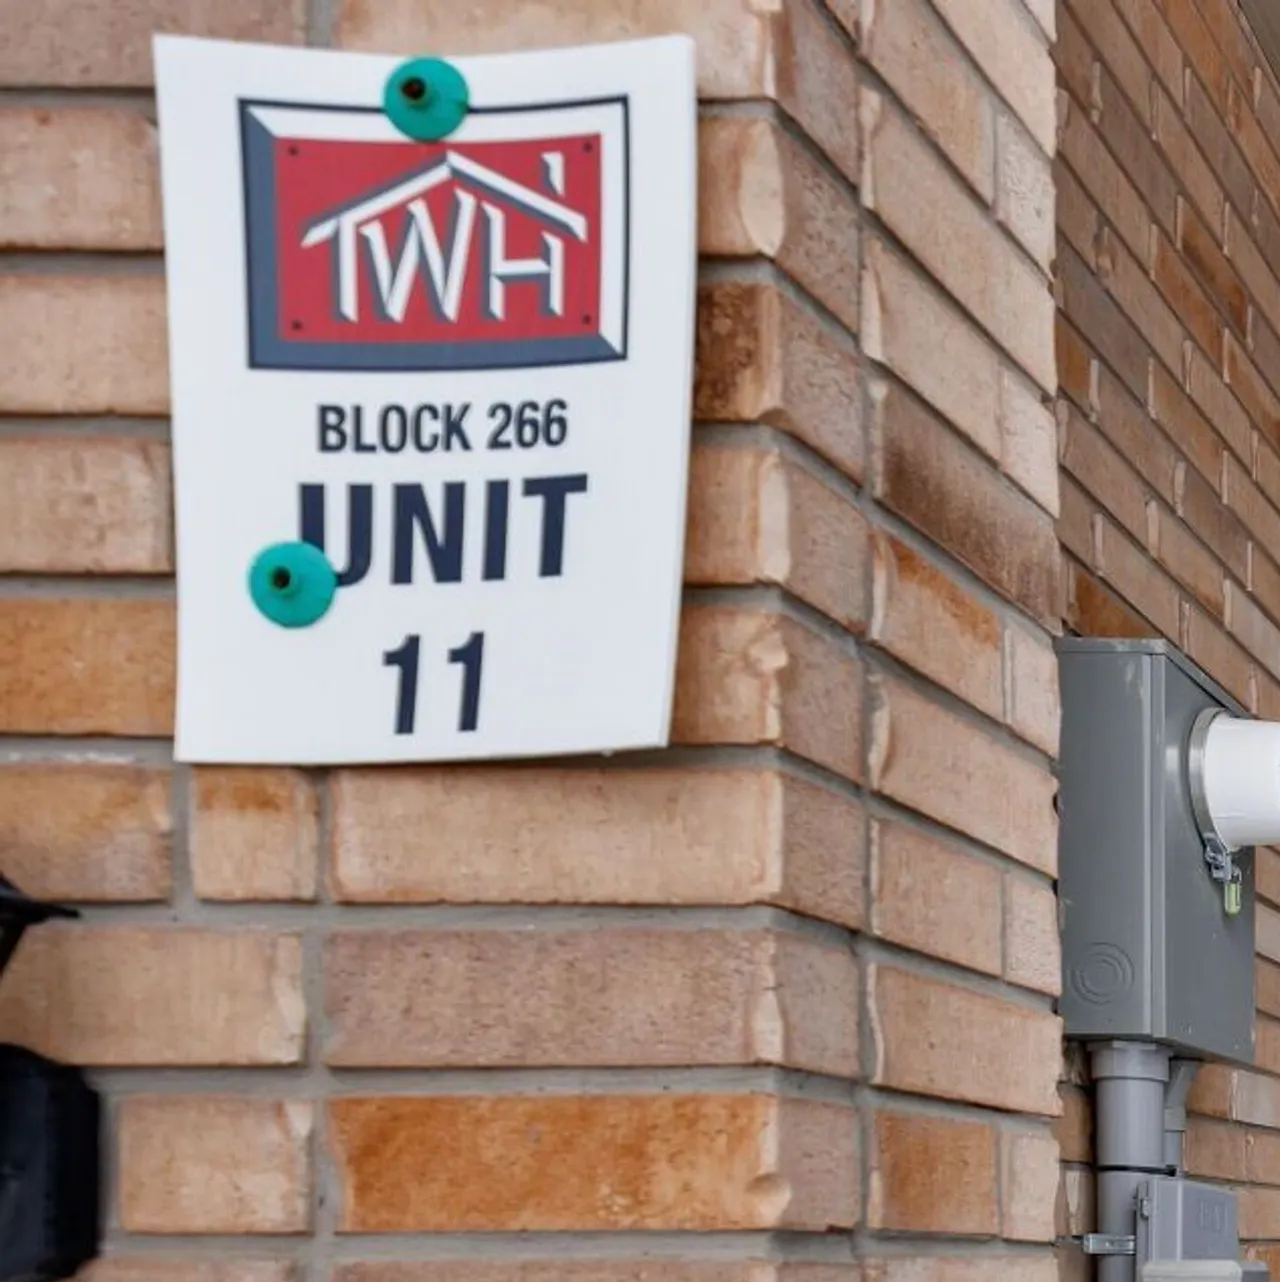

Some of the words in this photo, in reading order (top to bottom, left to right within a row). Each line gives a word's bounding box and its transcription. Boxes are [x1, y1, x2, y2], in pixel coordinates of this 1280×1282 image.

[317, 402, 473, 454] BLOCK
[486, 398, 569, 450] 266
[298, 473, 589, 588] UNIT
[382, 631, 485, 735] 11
